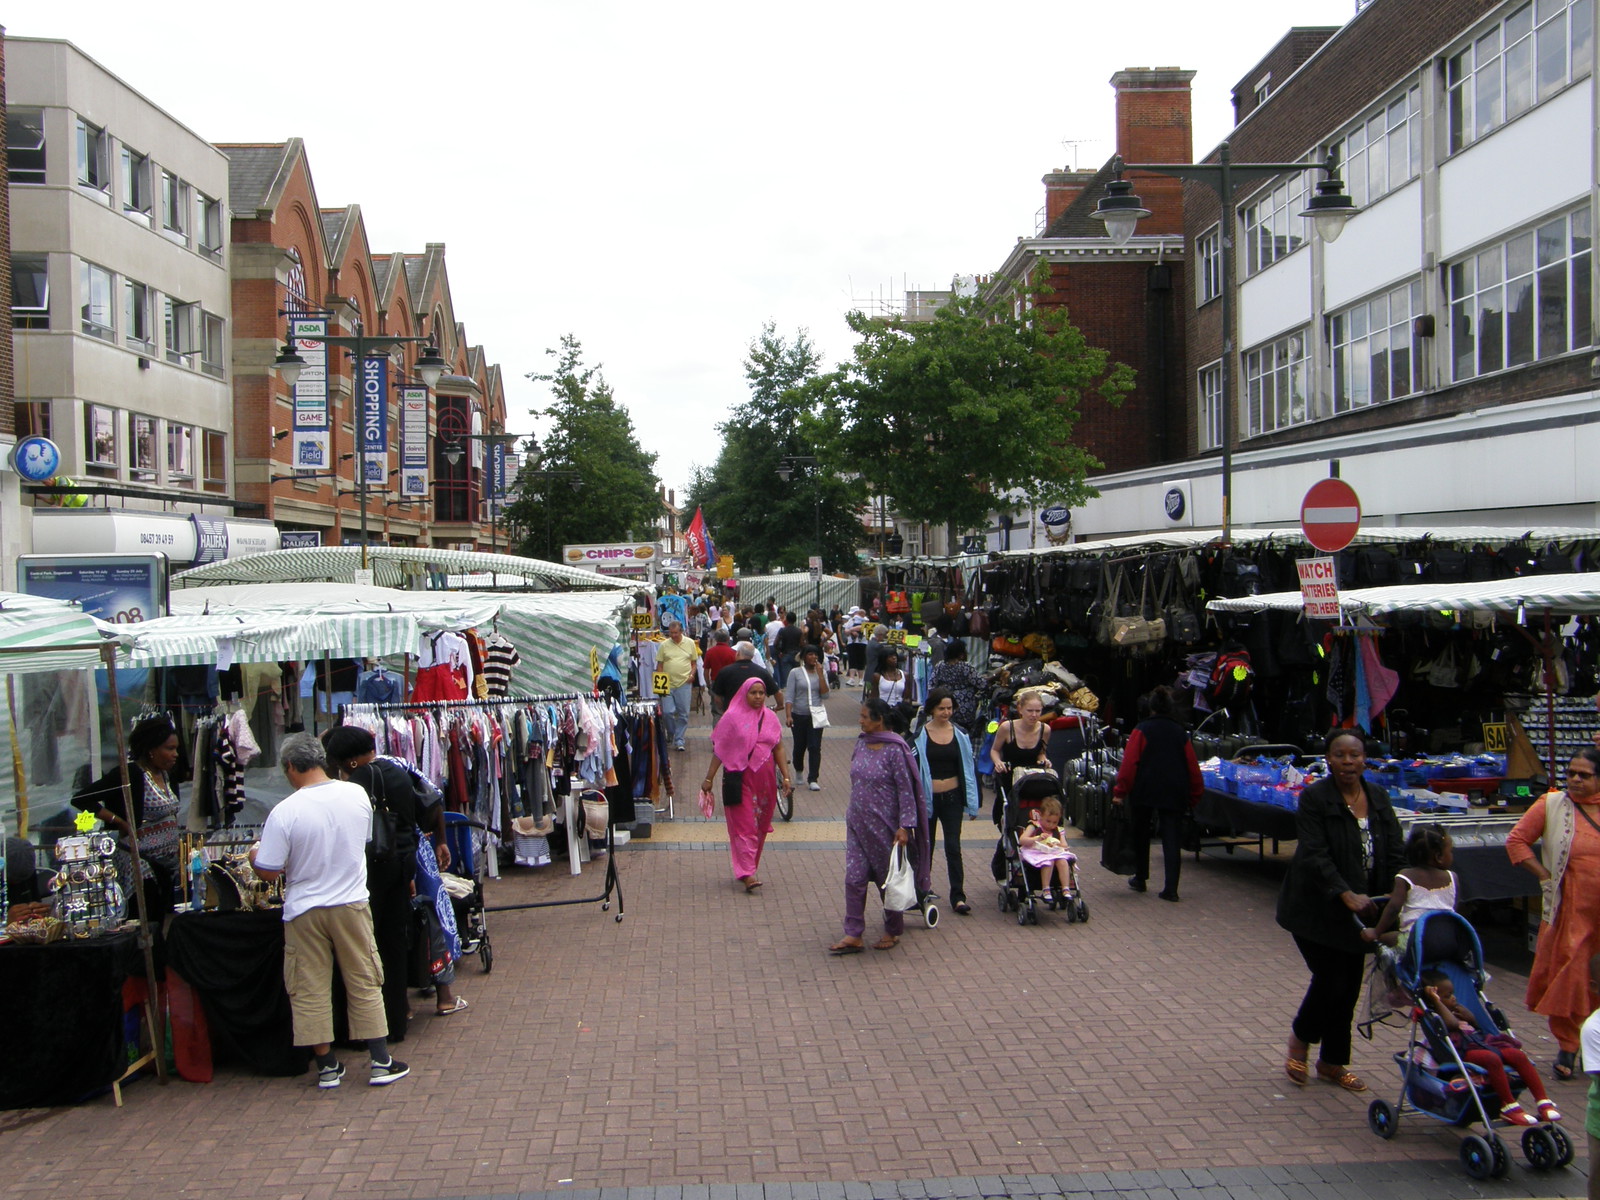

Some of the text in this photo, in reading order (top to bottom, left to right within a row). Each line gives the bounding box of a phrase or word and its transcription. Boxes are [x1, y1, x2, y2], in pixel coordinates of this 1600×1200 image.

[298, 324, 321, 332] ASDA
[299, 339, 322, 349] Argos
[364, 360, 380, 441] SHOPPING
[299, 413, 323, 421] GAME
[300, 450, 321, 460] Field
[1046, 509, 1068, 522] Boots
[140, 533, 154, 543] 08457
[155, 534, 162, 543] 39
[201, 533, 228, 549] HALIFAX
[282, 540, 316, 548] HALIFAX
[585, 548, 634, 559] CHIPS
[1298, 562, 1333, 579] WATCH
[1300, 582, 1336, 598] BATTERIES
[1319, 601, 1339, 614] HERE
[633, 614, 651, 625] £20
[654, 674, 668, 690] £2
